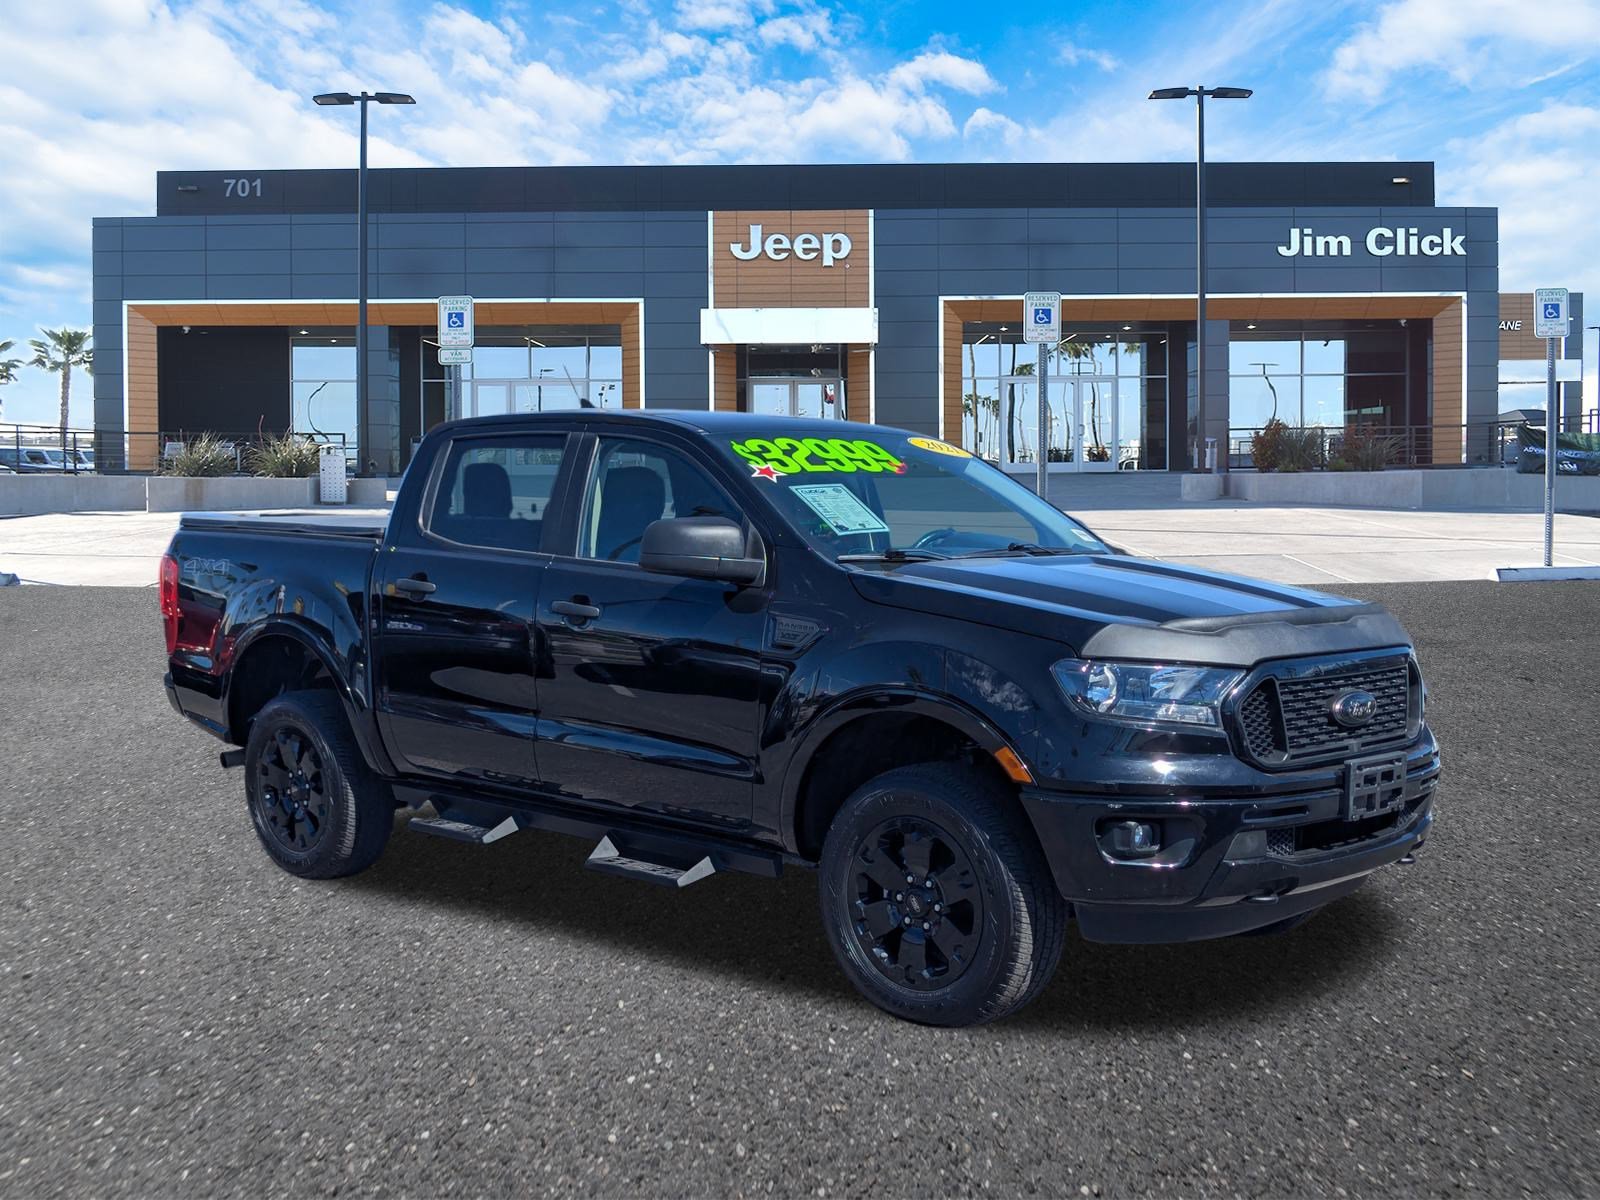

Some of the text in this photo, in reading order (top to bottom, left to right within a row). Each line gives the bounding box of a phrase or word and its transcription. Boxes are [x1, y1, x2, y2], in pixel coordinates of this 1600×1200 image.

[223, 178, 262, 197] 701
[729, 223, 852, 268] Jeep
[1277, 226, 1467, 256] Jim Click
[1498, 320, 1522, 331] ANE
